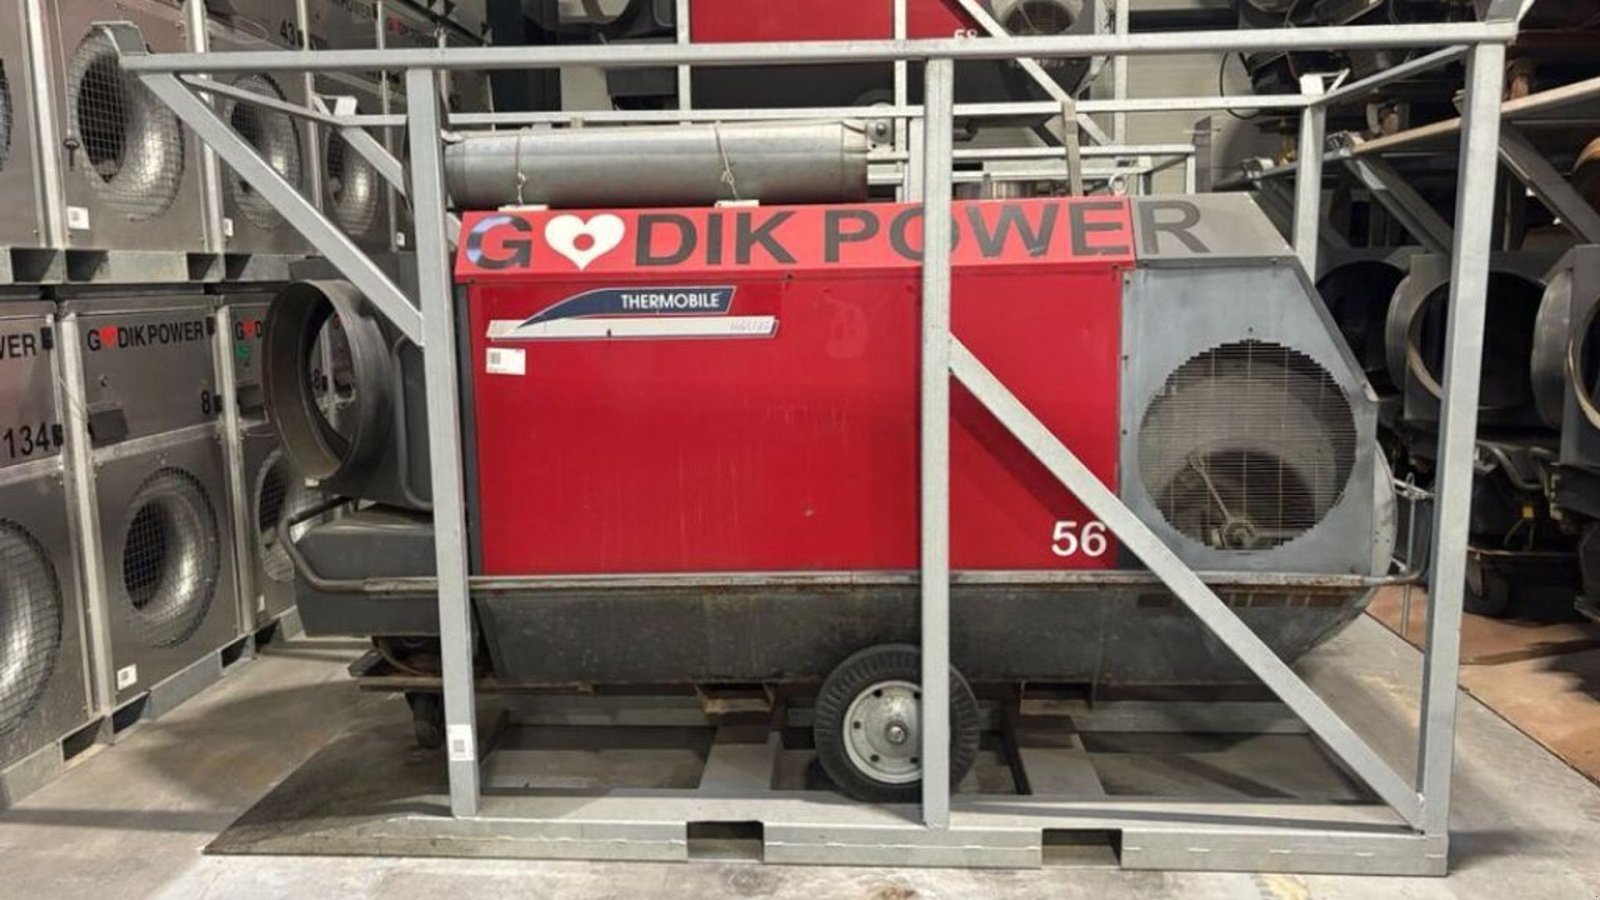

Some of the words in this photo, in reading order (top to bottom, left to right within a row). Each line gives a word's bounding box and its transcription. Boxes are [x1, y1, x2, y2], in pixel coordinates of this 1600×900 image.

[824, 199, 1211, 263] POWER
[620, 292, 720, 310] THERMOBILE
[149, 321, 204, 346] POWER
[201, 390, 211, 416] 8
[3, 421, 51, 459] 134
[1051, 520, 1107, 557] 56
